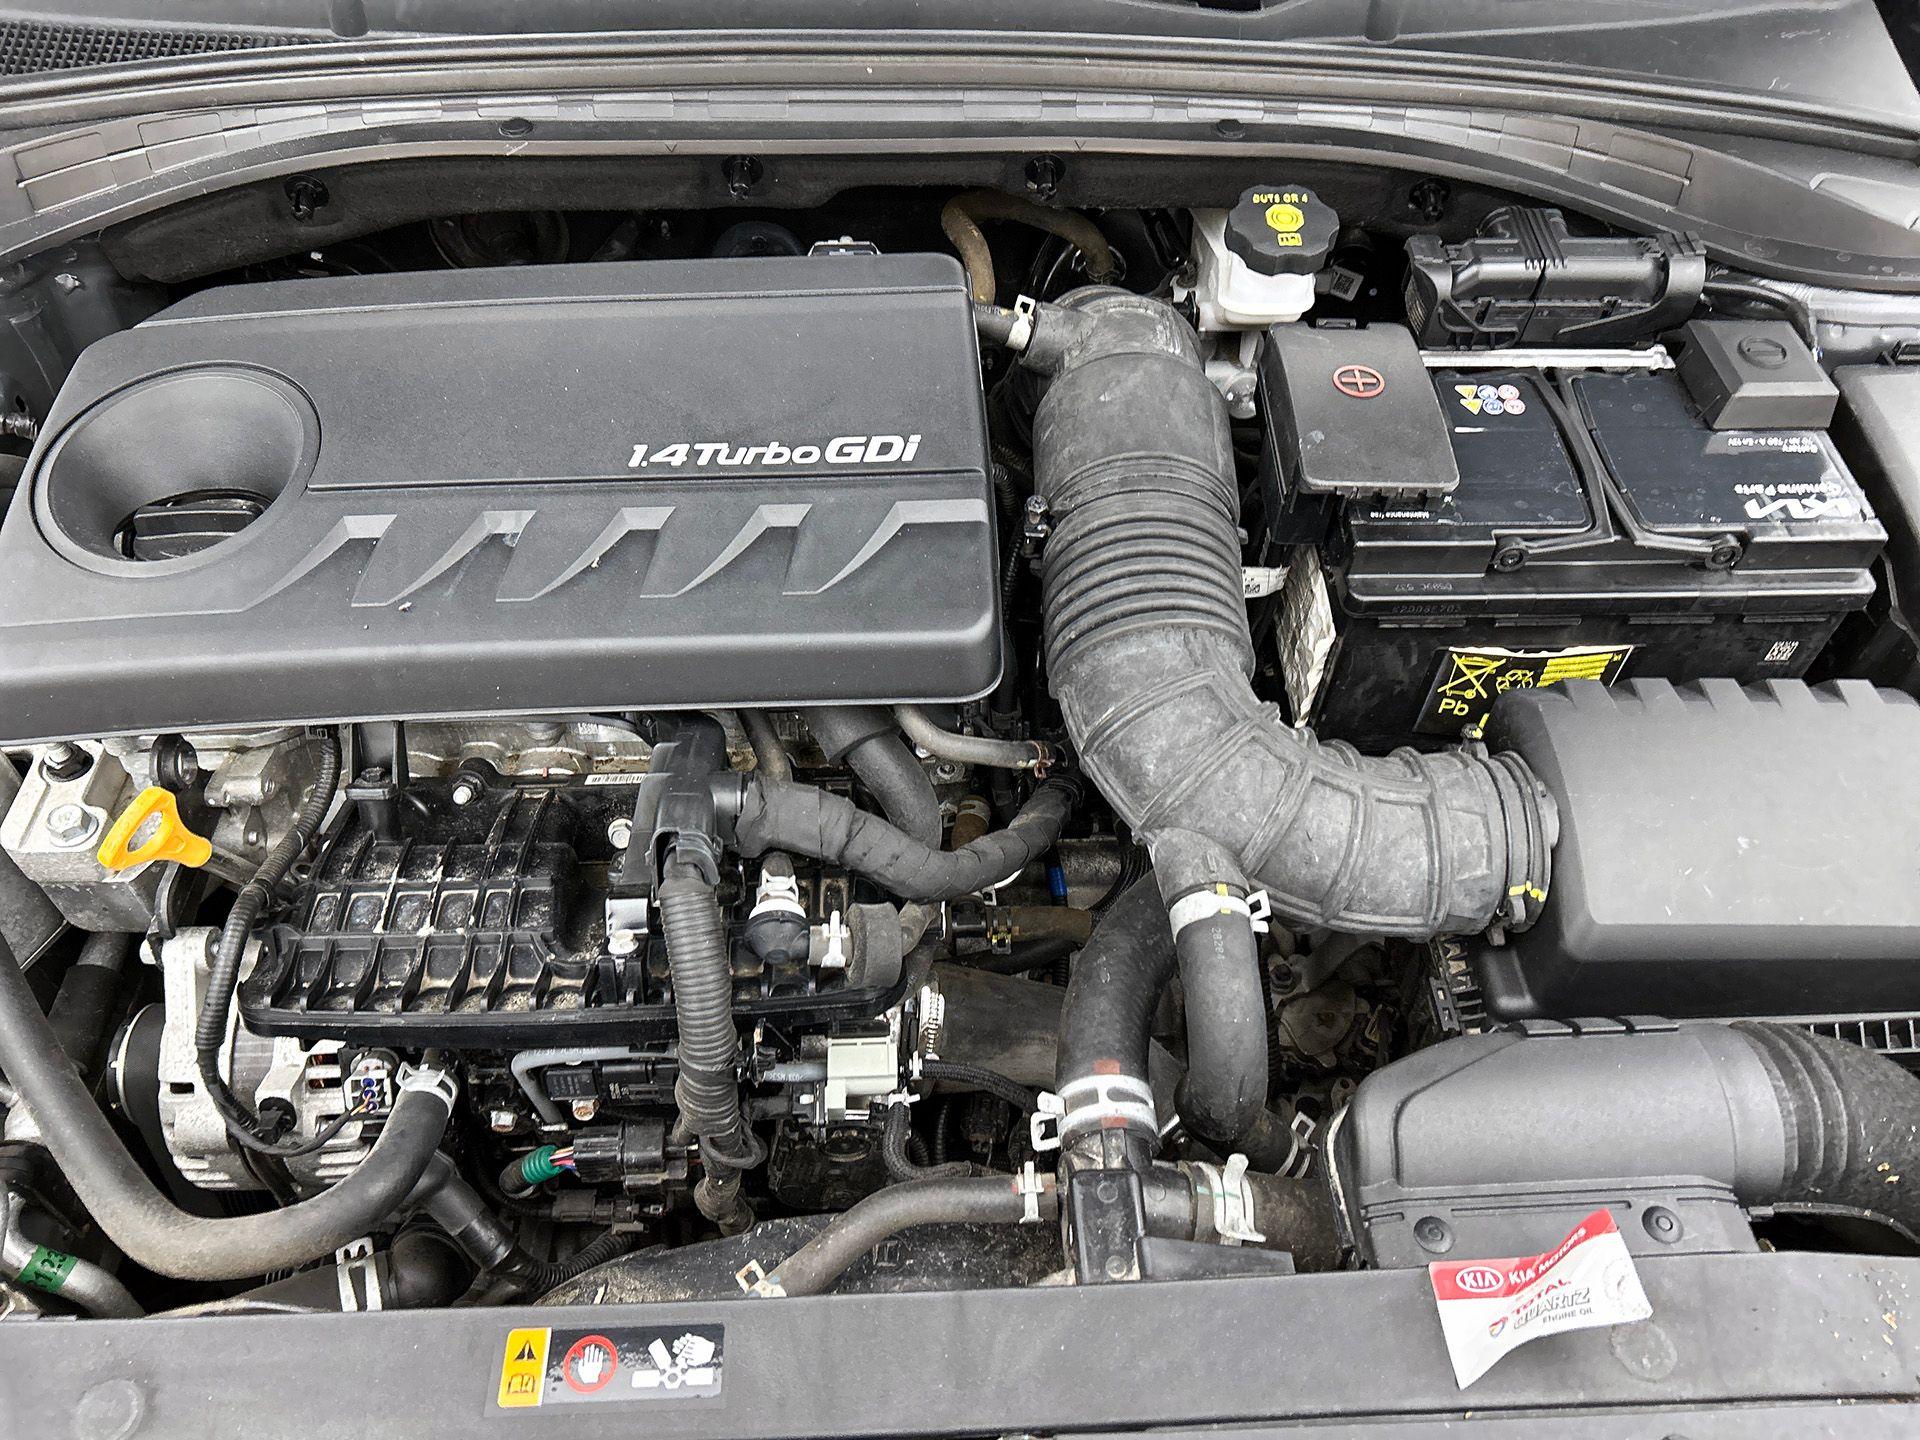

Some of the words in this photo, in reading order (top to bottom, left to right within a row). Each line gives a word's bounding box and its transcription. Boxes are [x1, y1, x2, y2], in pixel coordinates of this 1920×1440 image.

[1283, 193, 1299, 203] OR
[627, 443, 690, 468] 1.4
[693, 441, 821, 466] Turbo
[825, 434, 922, 464] GDi
[1734, 482, 1776, 497] Parts
[1777, 481, 1843, 497] Genuine
[1438, 698, 1469, 716] Pb
[1463, 1271, 1497, 1289] KIA
[1508, 1268, 1536, 1285] KIA
[1538, 1227, 1588, 1274] MOTORS
[1511, 1278, 1572, 1315] TOTAL
[1513, 1287, 1591, 1330] QUARTZ
[1542, 1308, 1577, 1324] ENGINE
[1579, 1305, 1595, 1316] OIL
